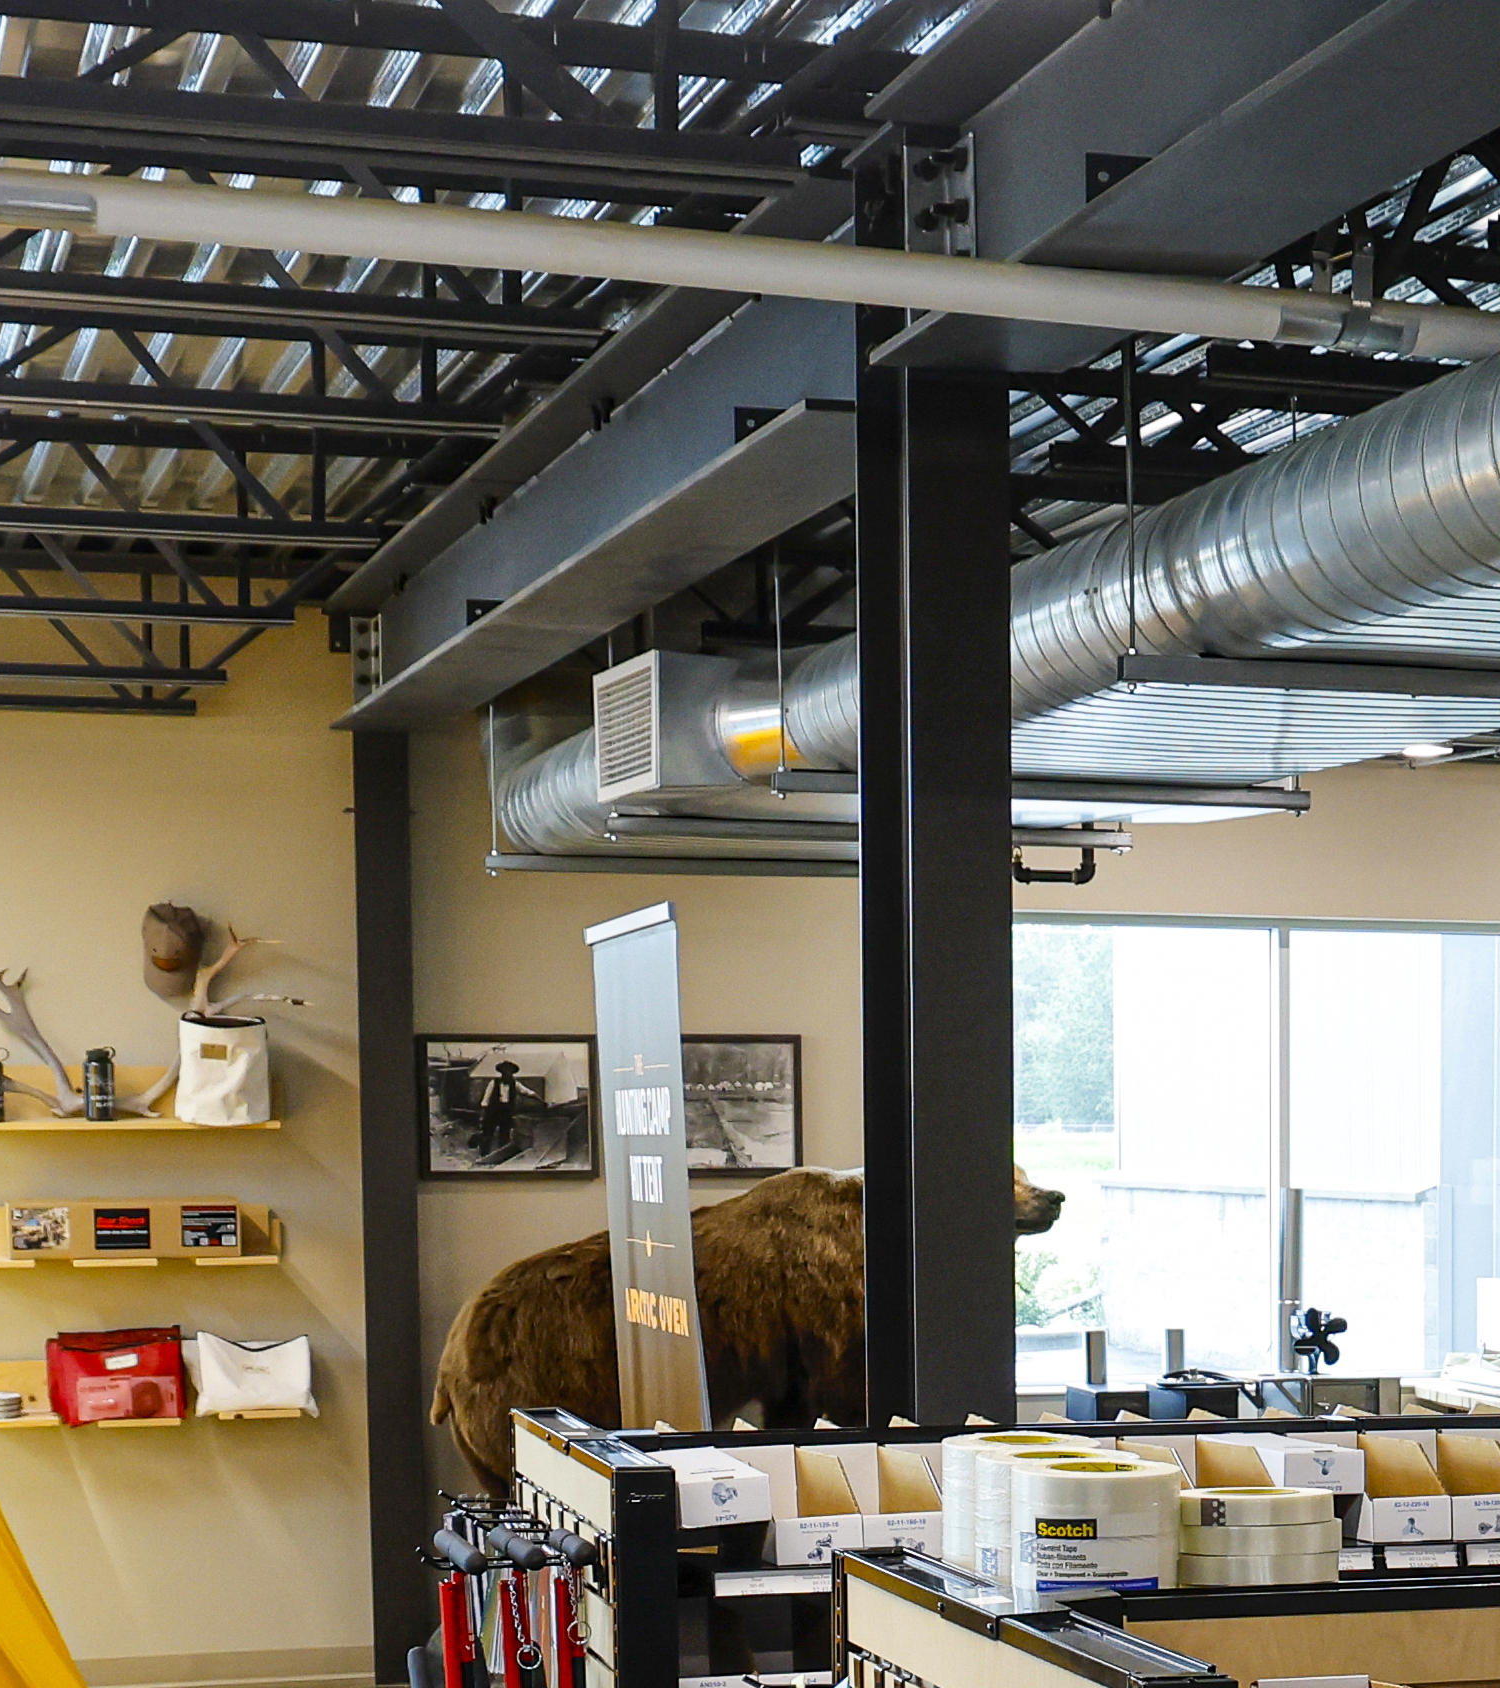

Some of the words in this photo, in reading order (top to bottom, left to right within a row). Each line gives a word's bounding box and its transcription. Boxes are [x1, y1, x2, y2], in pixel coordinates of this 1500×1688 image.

[615, 1088, 646, 1135] HUNTING
[647, 1087, 670, 1135] CAMP
[626, 1287, 657, 1330] ARCTIC
[659, 1294, 689, 1337] OVEN
[1037, 1522, 1095, 1537] Scotch
[1037, 1544, 1061, 1552] Filament
[1062, 1544, 1077, 1553] Tape
